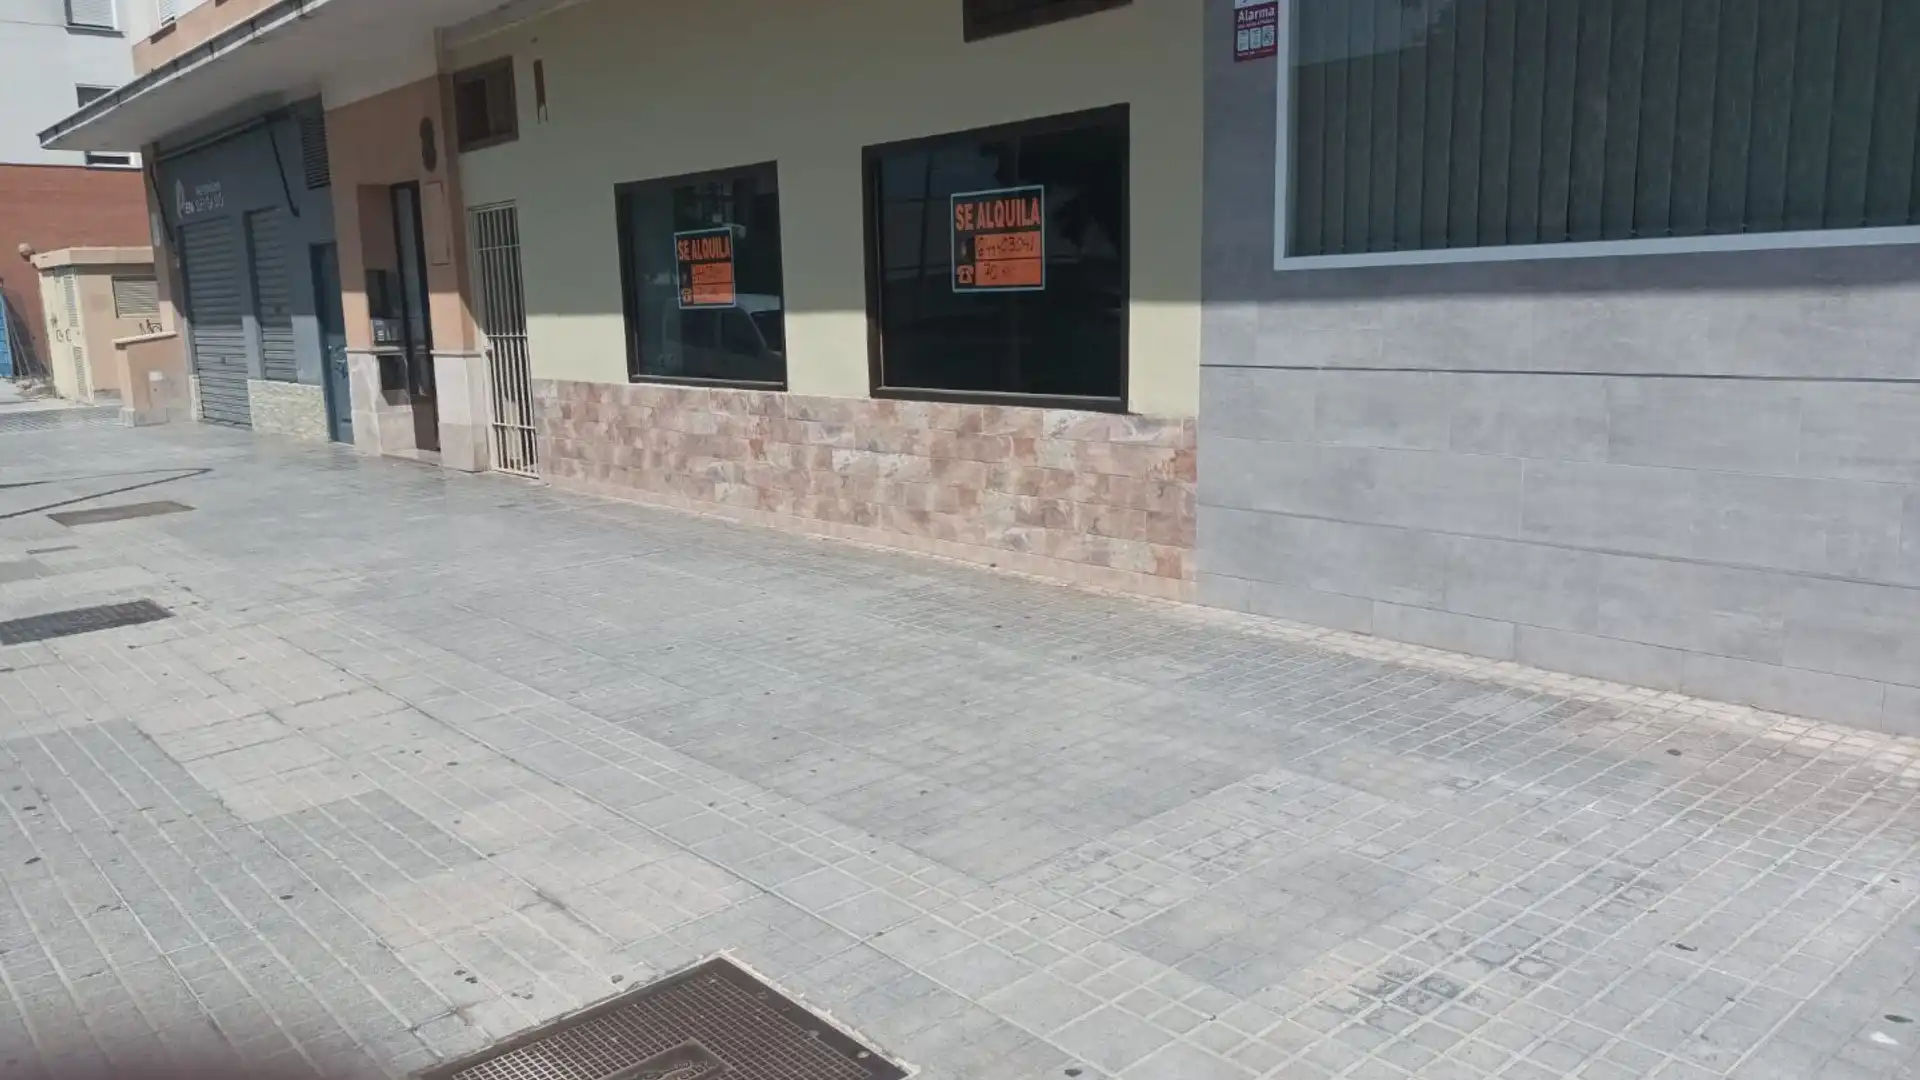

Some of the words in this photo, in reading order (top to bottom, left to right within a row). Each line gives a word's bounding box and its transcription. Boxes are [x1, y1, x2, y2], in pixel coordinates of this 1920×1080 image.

[1237, 7, 1275, 24] Alarma
[955, 203, 974, 231] SE
[976, 196, 1041, 229] ALQUILA
[677, 239, 691, 261] SE
[692, 235, 731, 260] ALQUILA
